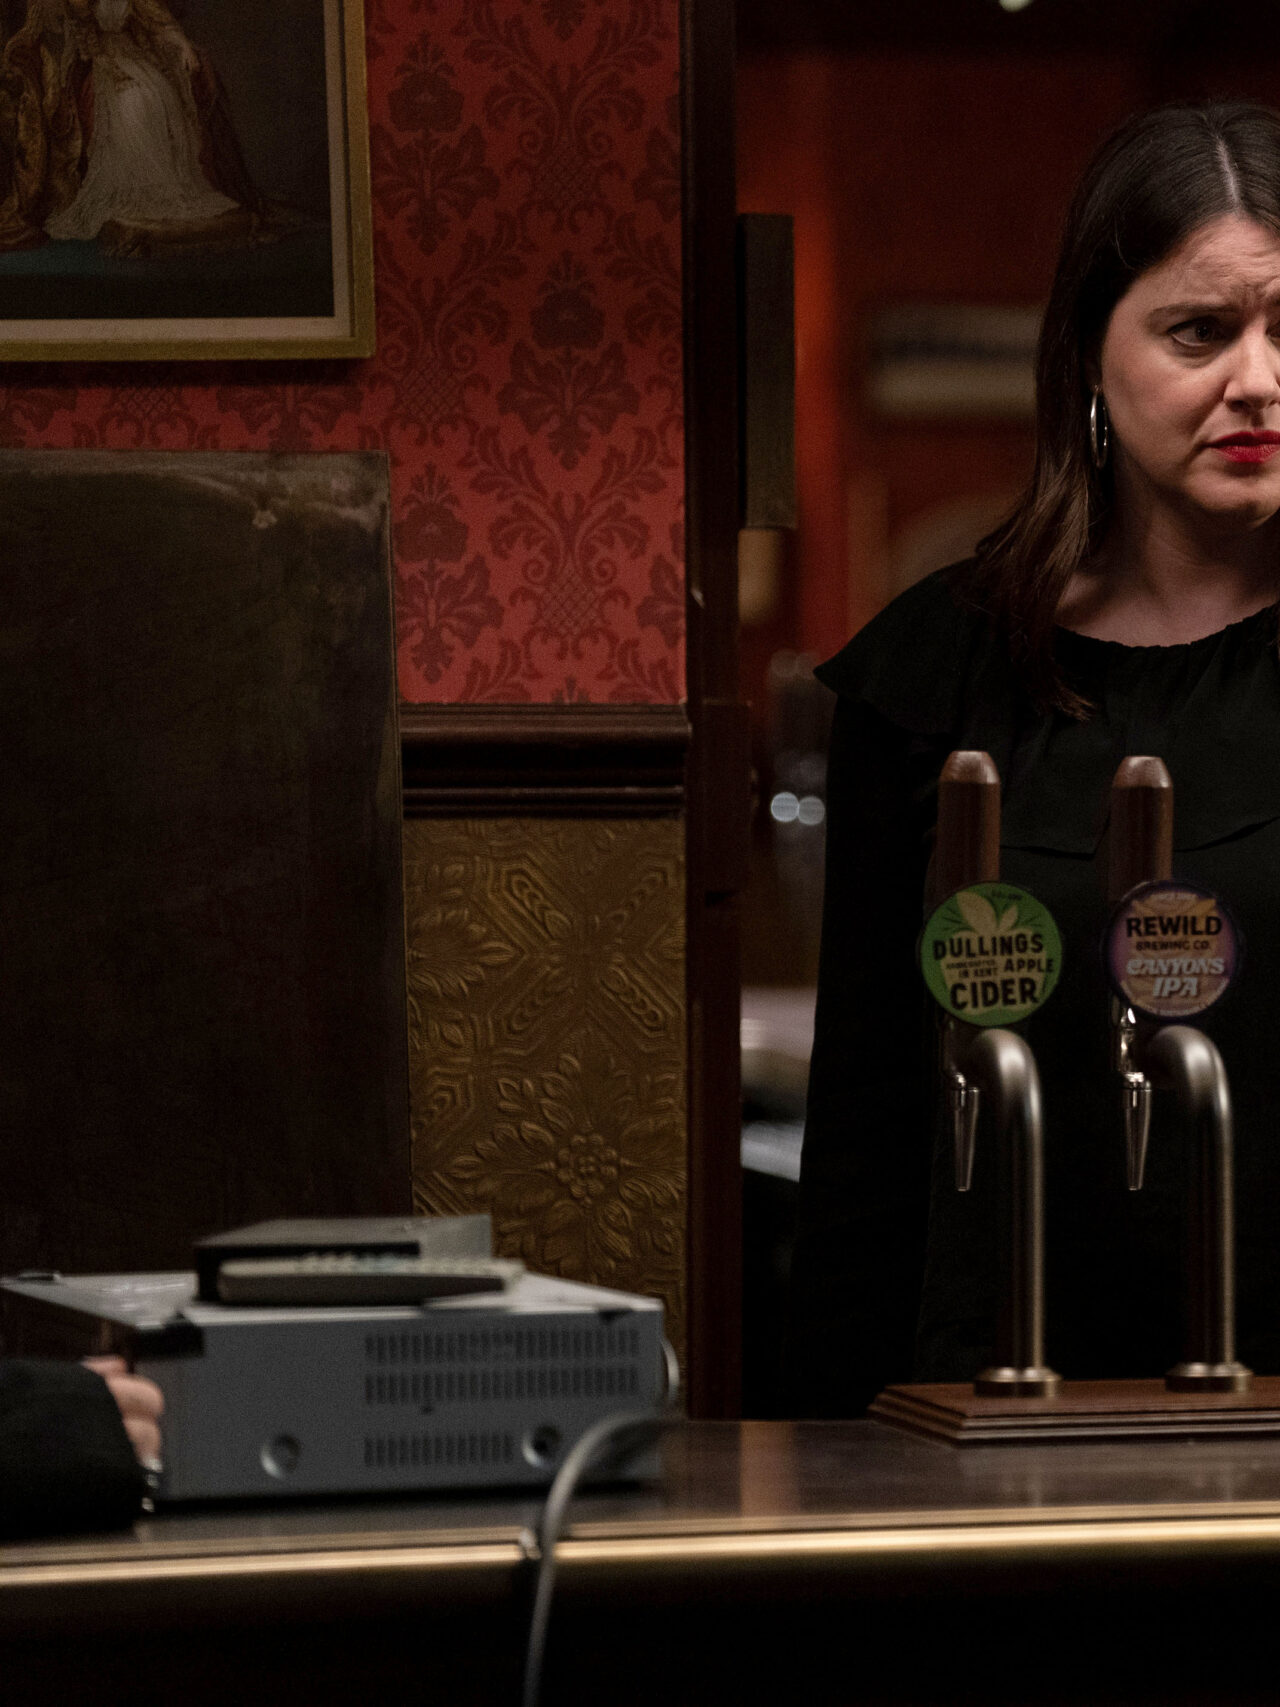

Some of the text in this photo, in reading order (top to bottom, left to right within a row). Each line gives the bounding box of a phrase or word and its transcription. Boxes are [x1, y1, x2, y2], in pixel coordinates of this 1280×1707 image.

[1127, 916, 1222, 937] REWILD
[934, 933, 1043, 960] DULLINGS
[1136, 941, 1189, 951] BREWING
[1004, 959, 1054, 973] APPLE
[1126, 958, 1225, 976] CANYONS
[951, 977, 1038, 1010] CIDER
[1151, 977, 1199, 998] IPA
